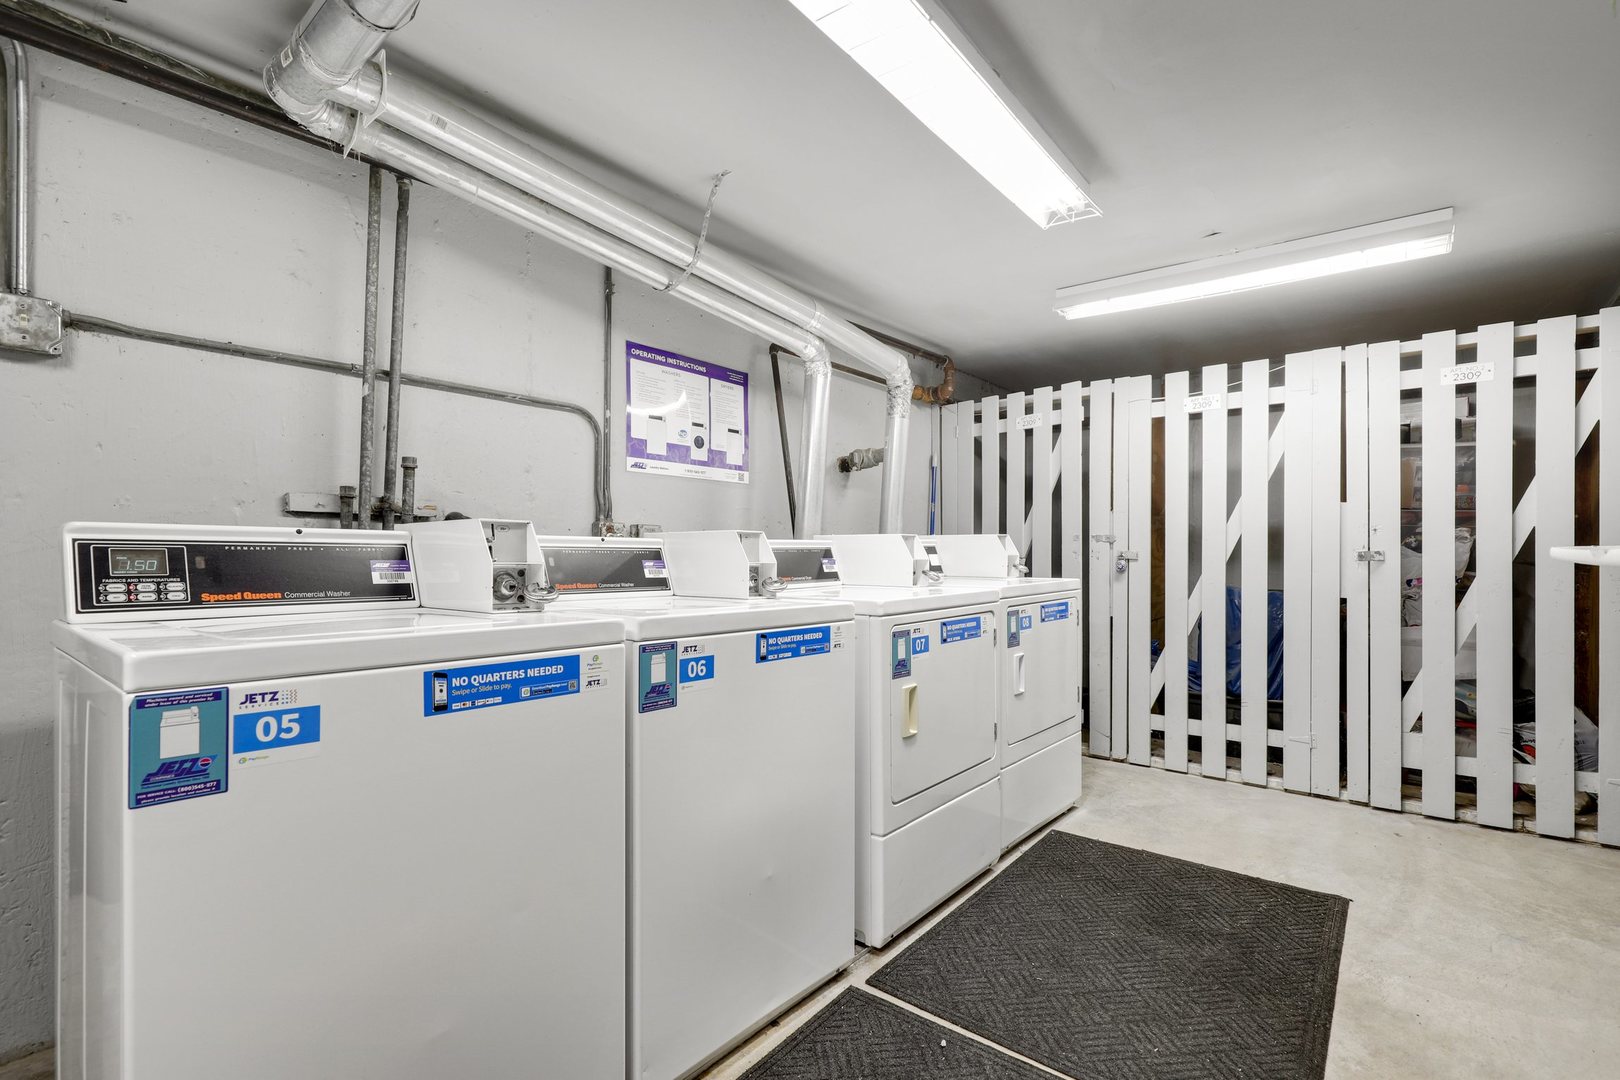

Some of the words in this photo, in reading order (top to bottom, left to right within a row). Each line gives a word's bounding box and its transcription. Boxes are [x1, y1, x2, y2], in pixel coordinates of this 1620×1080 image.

[631, 348, 666, 362] OPERATING
[666, 357, 706, 372] INSTRUCTIONS
[1453, 370, 1482, 381] 2309
[201, 592, 242, 602] Speed
[244, 592, 282, 600] Queen
[777, 634, 803, 644] QUARTERS
[804, 632, 822, 640] NEEDED
[682, 645, 697, 654] JETZ
[916, 638, 926, 652] 07
[452, 676, 468, 687] NO
[471, 670, 525, 685] QUARTERS
[527, 664, 564, 678] NEEDED
[688, 660, 706, 678] 06
[586, 679, 600, 687] JETZ
[452, 688, 469, 697] Swipe
[501, 684, 512, 692] pay.
[240, 691, 279, 706] JETZ
[256, 712, 300, 742] 05
